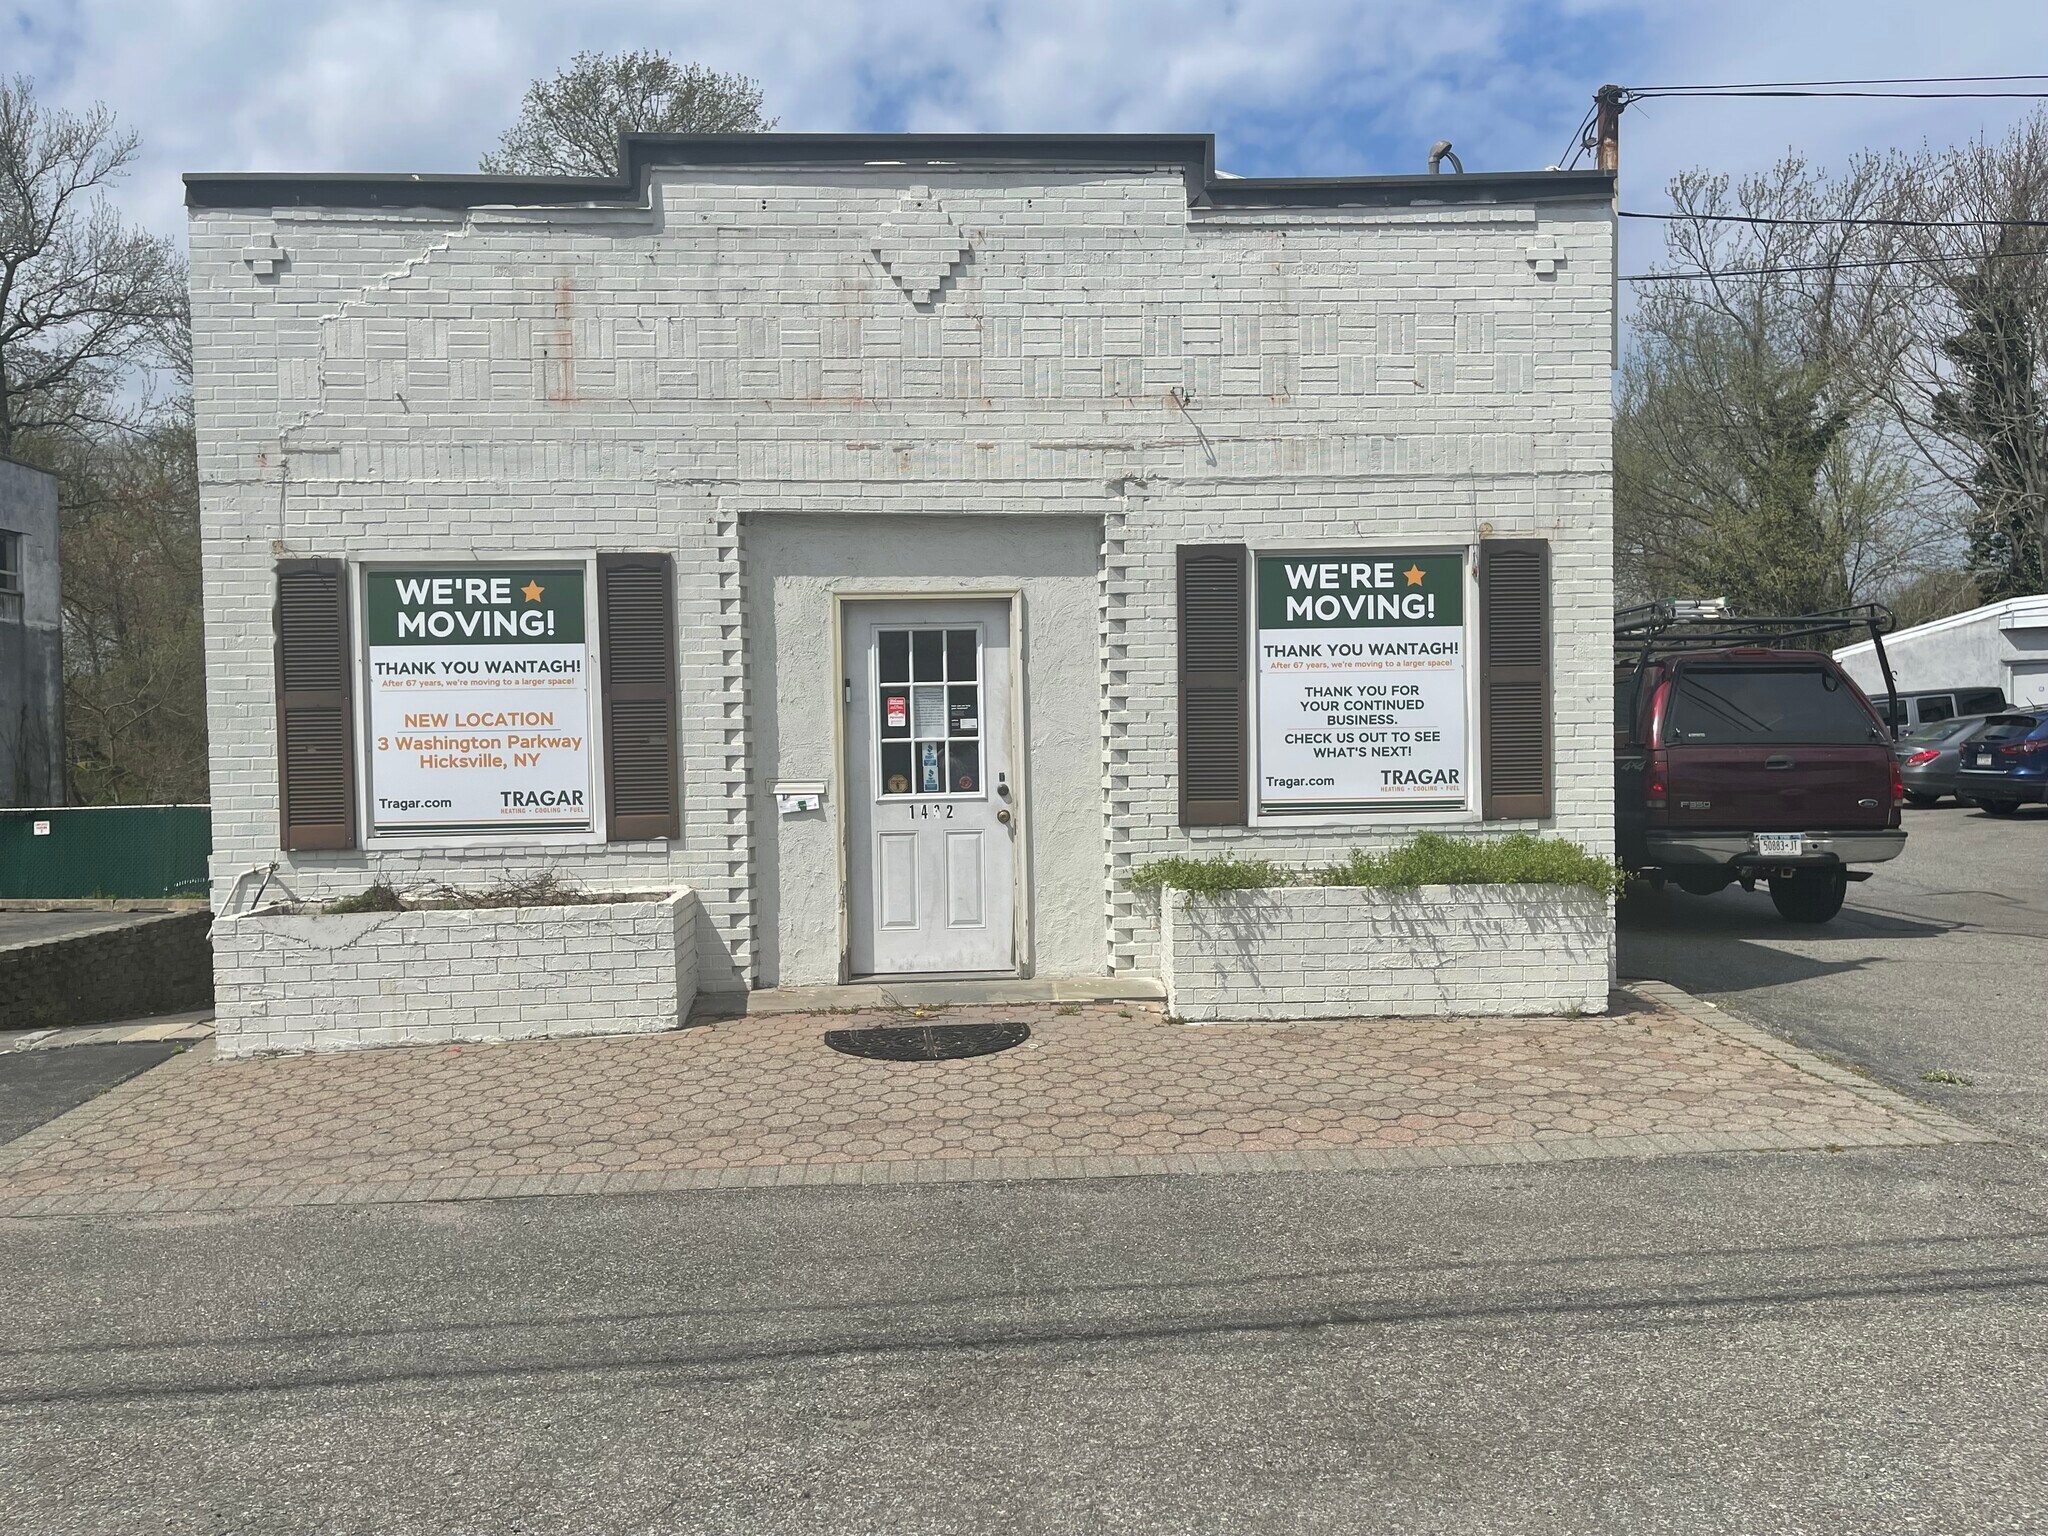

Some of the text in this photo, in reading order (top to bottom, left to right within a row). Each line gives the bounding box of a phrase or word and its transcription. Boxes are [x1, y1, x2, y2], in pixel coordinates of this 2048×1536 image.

[1285, 563, 1394, 589] WE'RE
[396, 579, 511, 605] WE'RE
[1286, 594, 1435, 621] MOVING!
[398, 610, 555, 637] MOVING!
[1264, 642, 1458, 657] THANK YOU WANTAGH!
[375, 660, 580, 675] THANK YOU WANTAGH!
[1403, 660, 1425, 668] larger
[1428, 660, 1452, 668] space!
[471, 678, 500, 687] moving
[522, 678, 545, 686] larger
[548, 678, 574, 686] space!
[1305, 685, 1419, 697] THANK YOU FOR
[1300, 700, 1424, 712] YOUR CONTINUED
[404, 712, 554, 728] NEW LOCATION
[1327, 714, 1398, 726] BUSINESS.
[377, 734, 582, 753] 3 Washington Parkway
[1284, 731, 1440, 744] CHECK US OUT TO SEE
[1313, 746, 1412, 758] WHAT'S NEXT!
[420, 753, 540, 770] Hicksville, NY
[1266, 776, 1334, 788] Tragar.com
[1380, 769, 1459, 785] TRAGAR
[379, 799, 451, 811] Tragar.com
[500, 790, 584, 807] TRAGAR
